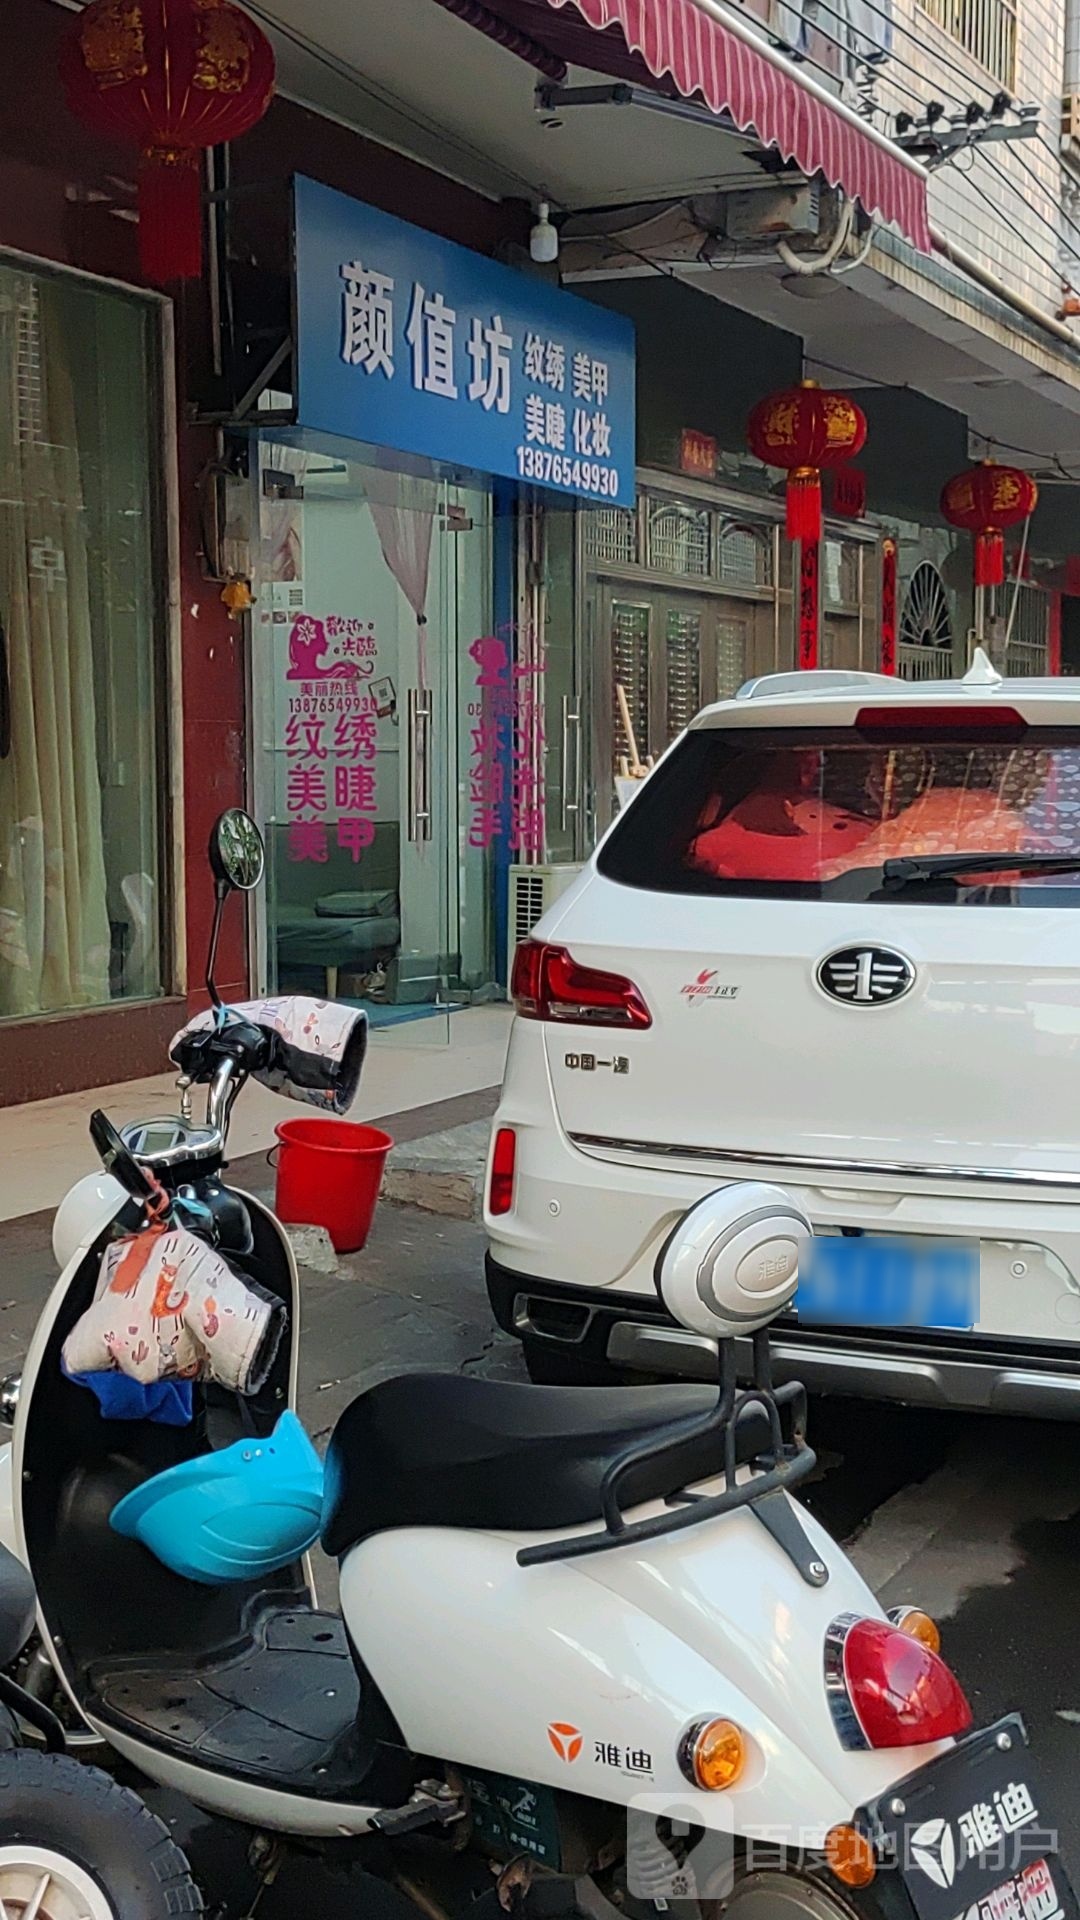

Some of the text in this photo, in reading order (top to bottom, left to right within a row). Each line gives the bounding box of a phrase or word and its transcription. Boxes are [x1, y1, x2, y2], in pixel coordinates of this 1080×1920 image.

[339, 260, 515, 414] 颜值坊
[522, 331, 609, 406] 纹绣 美甲
[524, 393, 612, 457] 美睫 化妆
[516, 446, 619, 498] 13876549930
[289, 698, 378, 713] 13876549930
[300, 681, 359, 697] 美丽热线
[285, 713, 377, 761] 纹绣
[286, 763, 378, 811] 美睫
[286, 813, 377, 864] 美甲
[593, 1740, 654, 1775] 雅迪
[957, 1782, 1040, 1858] 雅迪
